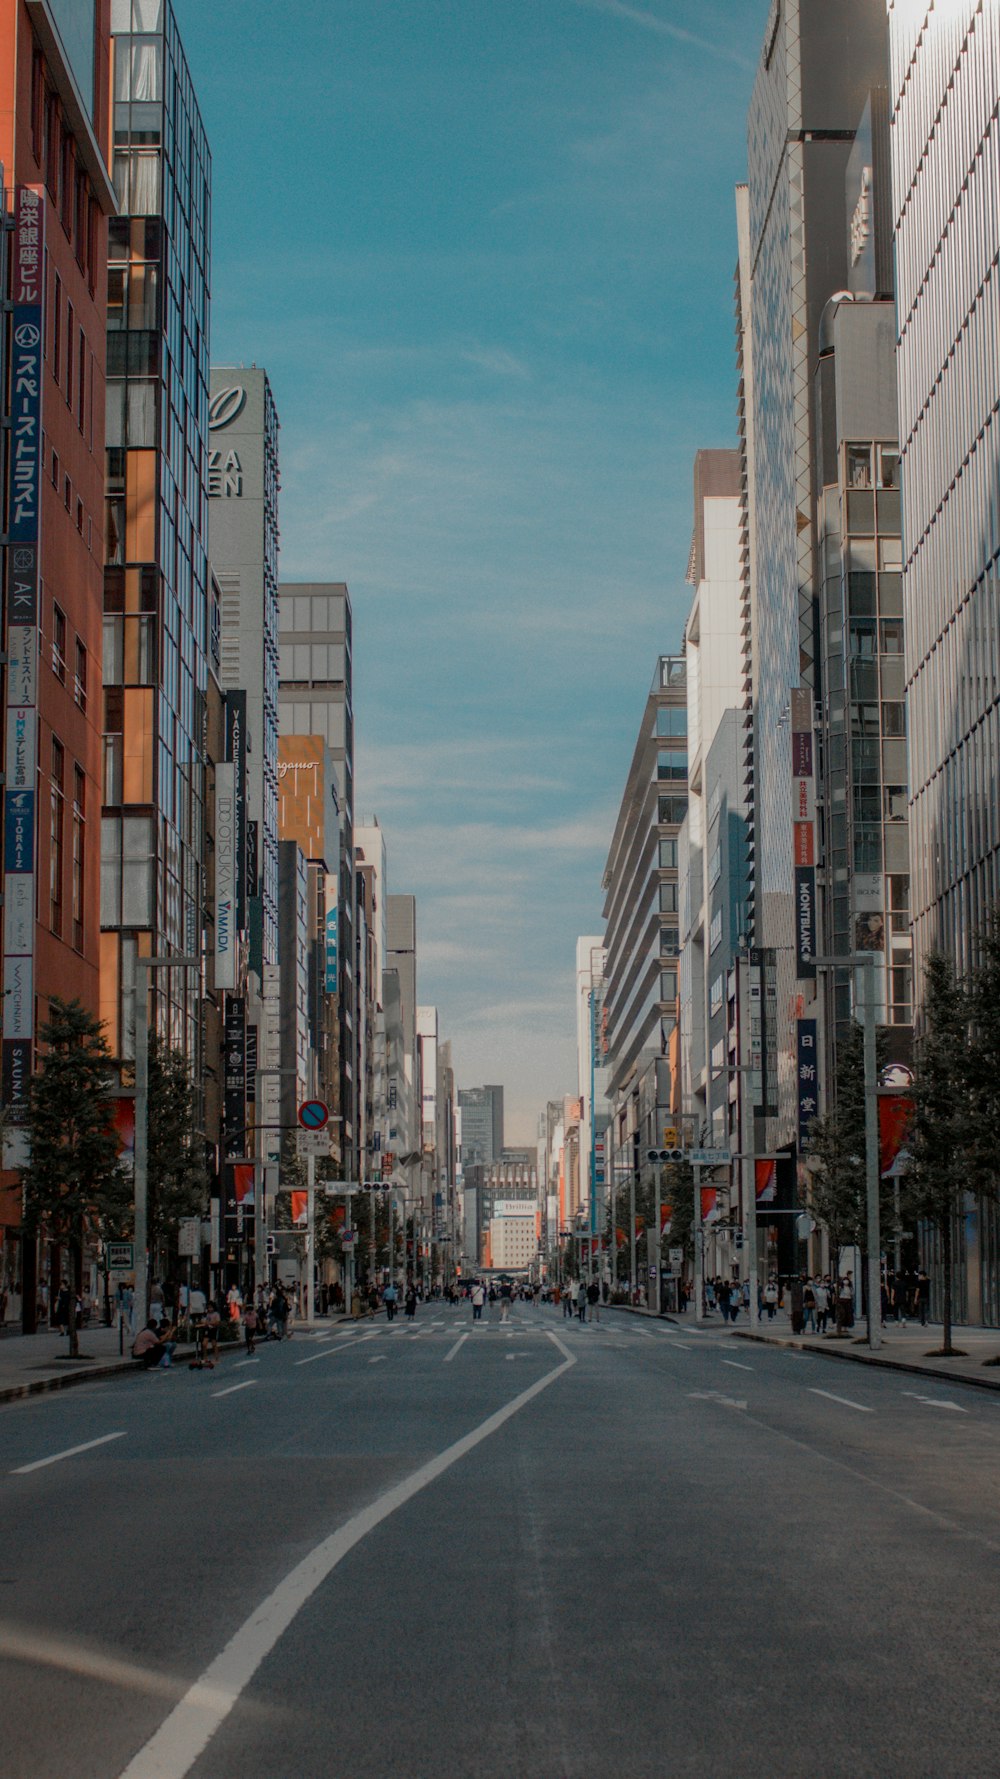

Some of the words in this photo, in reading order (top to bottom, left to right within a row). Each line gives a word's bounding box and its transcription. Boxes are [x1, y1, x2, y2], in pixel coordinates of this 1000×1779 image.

[18, 189, 39, 302] 陽栄銀座ビル
[14, 355, 38, 524] スペーストラスト
[13, 582, 32, 607] AK
[21, 627, 33, 705] ランドエスパース
[15, 817, 24, 868] TORAIZ
[218, 825, 232, 886] OTSUKA
[217, 901, 231, 953] YAMADA
[799, 882, 811, 953] MONTBLANC
[13, 964, 23, 1033] WATCHNIAN
[12, 1048, 23, 1100] SAUNA
[246, 1033, 257, 1094] DAMIANI
[799, 1035, 816, 1112] 日新堂
